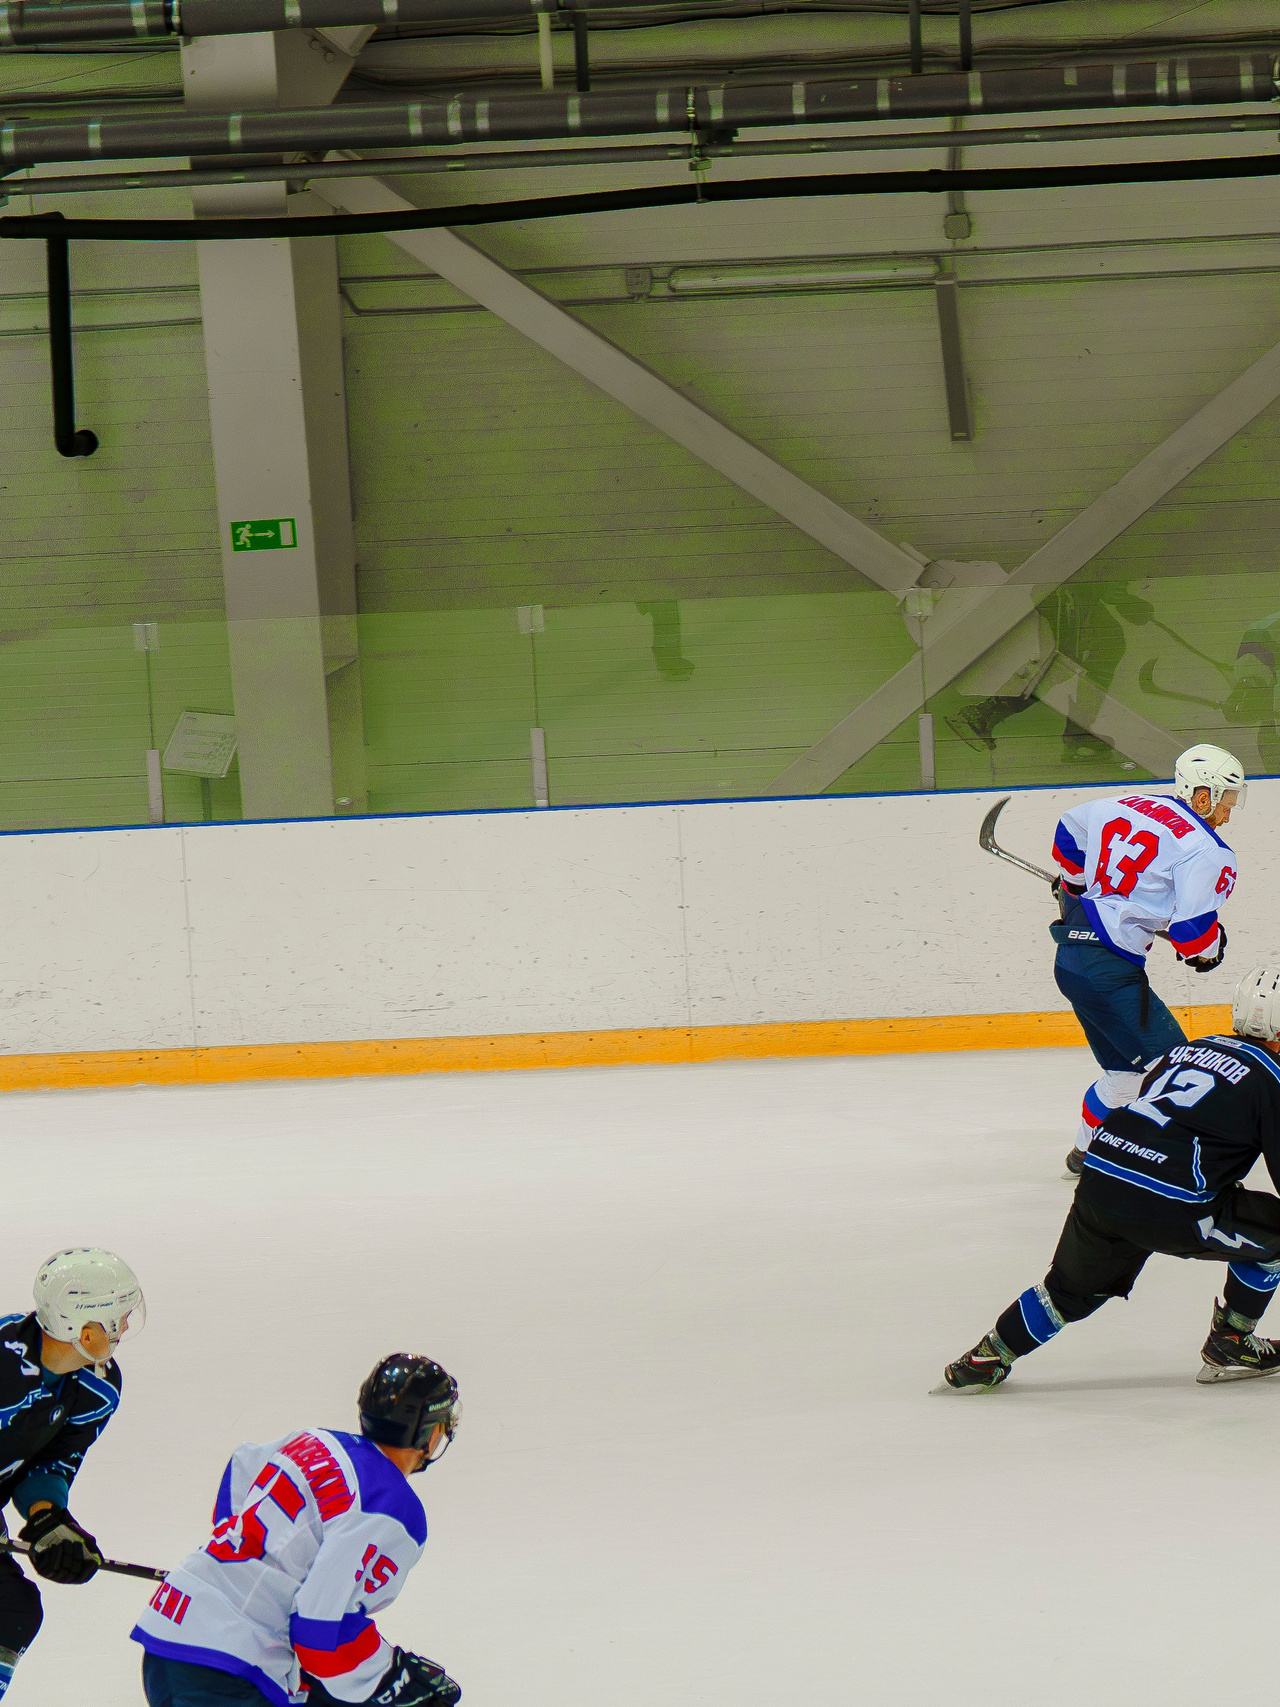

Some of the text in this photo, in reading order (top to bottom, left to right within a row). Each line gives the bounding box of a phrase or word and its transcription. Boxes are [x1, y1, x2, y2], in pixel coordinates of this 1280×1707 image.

[1117, 796, 1196, 839] САЛЬНИКОВ
[1090, 816, 1160, 899] 63
[1068, 930, 1100, 941] BAU
[1099, 1131, 1169, 1164] ONE TIMER
[149, 1581, 192, 1627] CHI
